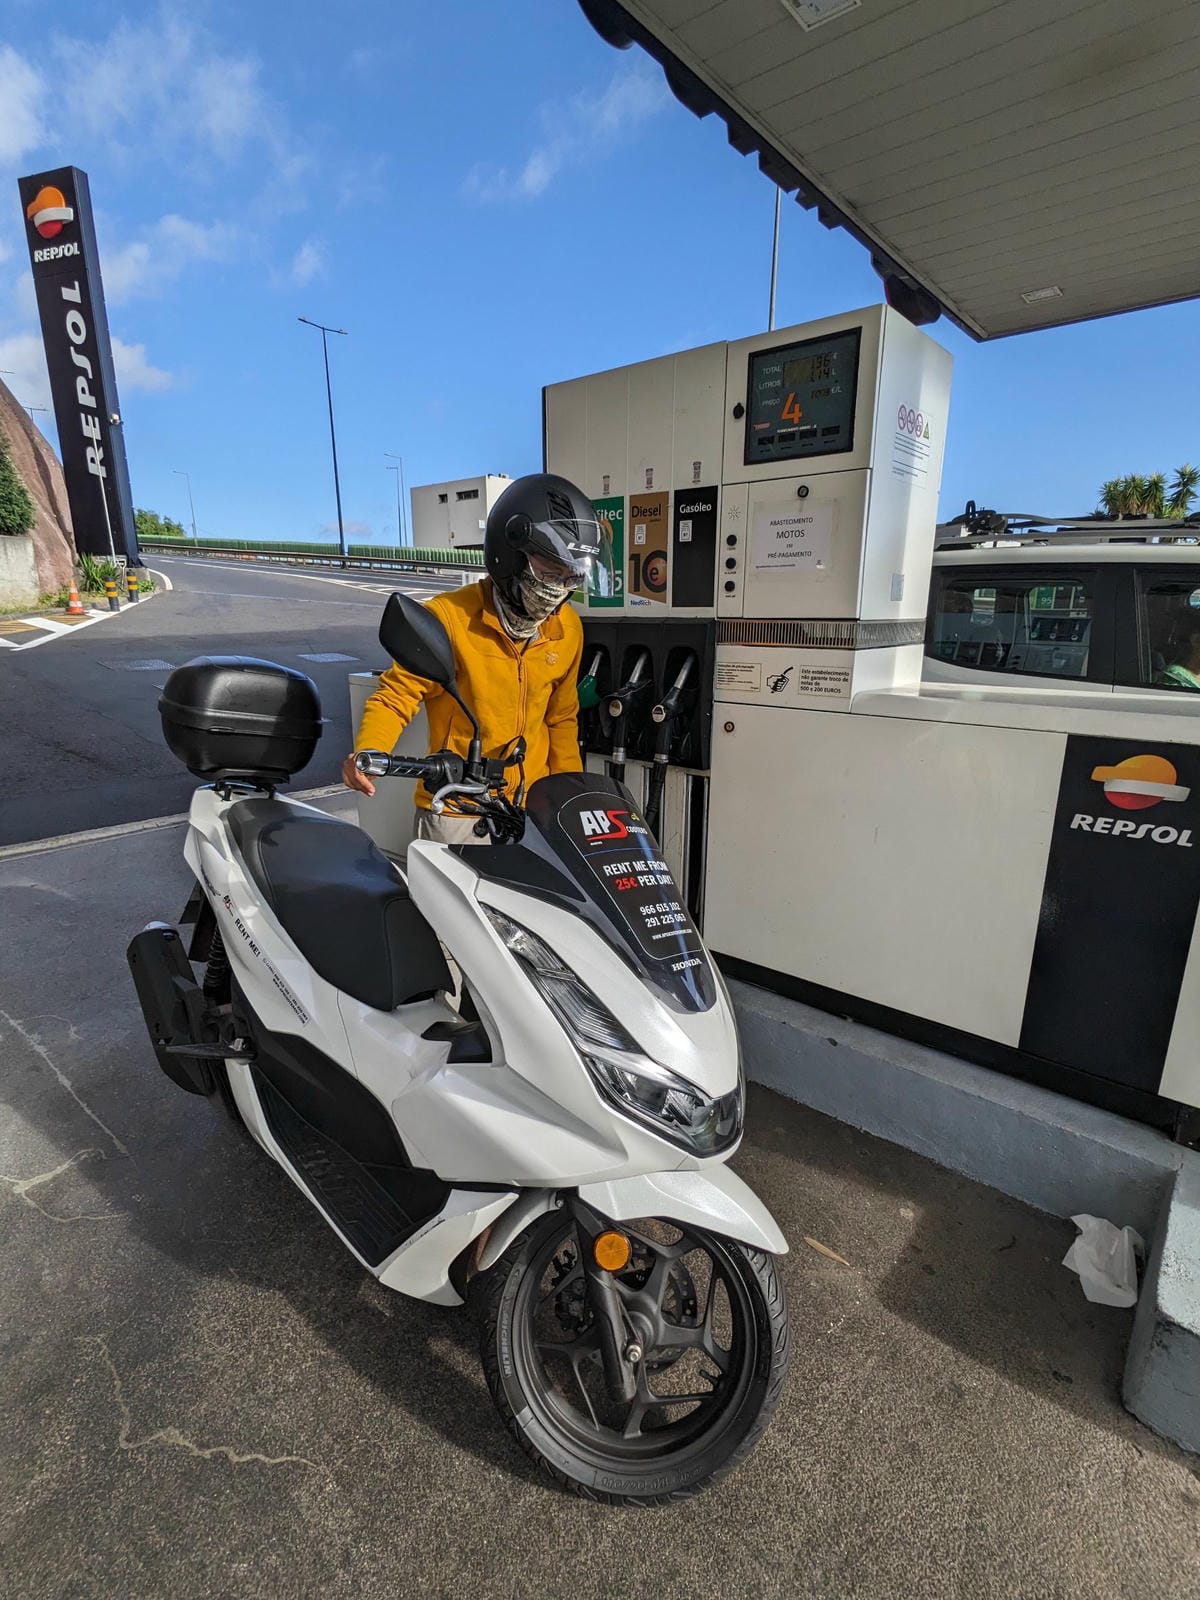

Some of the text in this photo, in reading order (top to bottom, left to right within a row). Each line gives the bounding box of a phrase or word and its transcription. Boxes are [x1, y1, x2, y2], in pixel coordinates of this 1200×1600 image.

[34, 242, 80, 263] REPSOL
[763, 365, 782, 375] TOTAL
[61, 280, 107, 479] REPSOL
[759, 380, 781, 390] LITROS
[781, 391, 802, 424] 4
[596, 508, 623, 521] fitec
[631, 504, 661, 518] Diesel
[679, 502, 712, 514] Gasóleo
[769, 517, 814, 526] ABASTECIMENTO
[776, 529, 805, 539] MOTOS
[566, 542, 601, 555] LS2
[767, 551, 812, 559] PRÉ-PAGAMENTO
[1070, 813, 1193, 847] REPSOL
[603, 860, 669, 877] RENT ME FROM
[615, 874, 674, 891] 25€ PER DAY!
[640, 902, 681, 915] 966 615 102
[645, 916, 660, 928] 291
[660, 915, 674, 925] 225
[235, 918, 250, 940] RENT
[671, 958, 702, 972] HONDA
